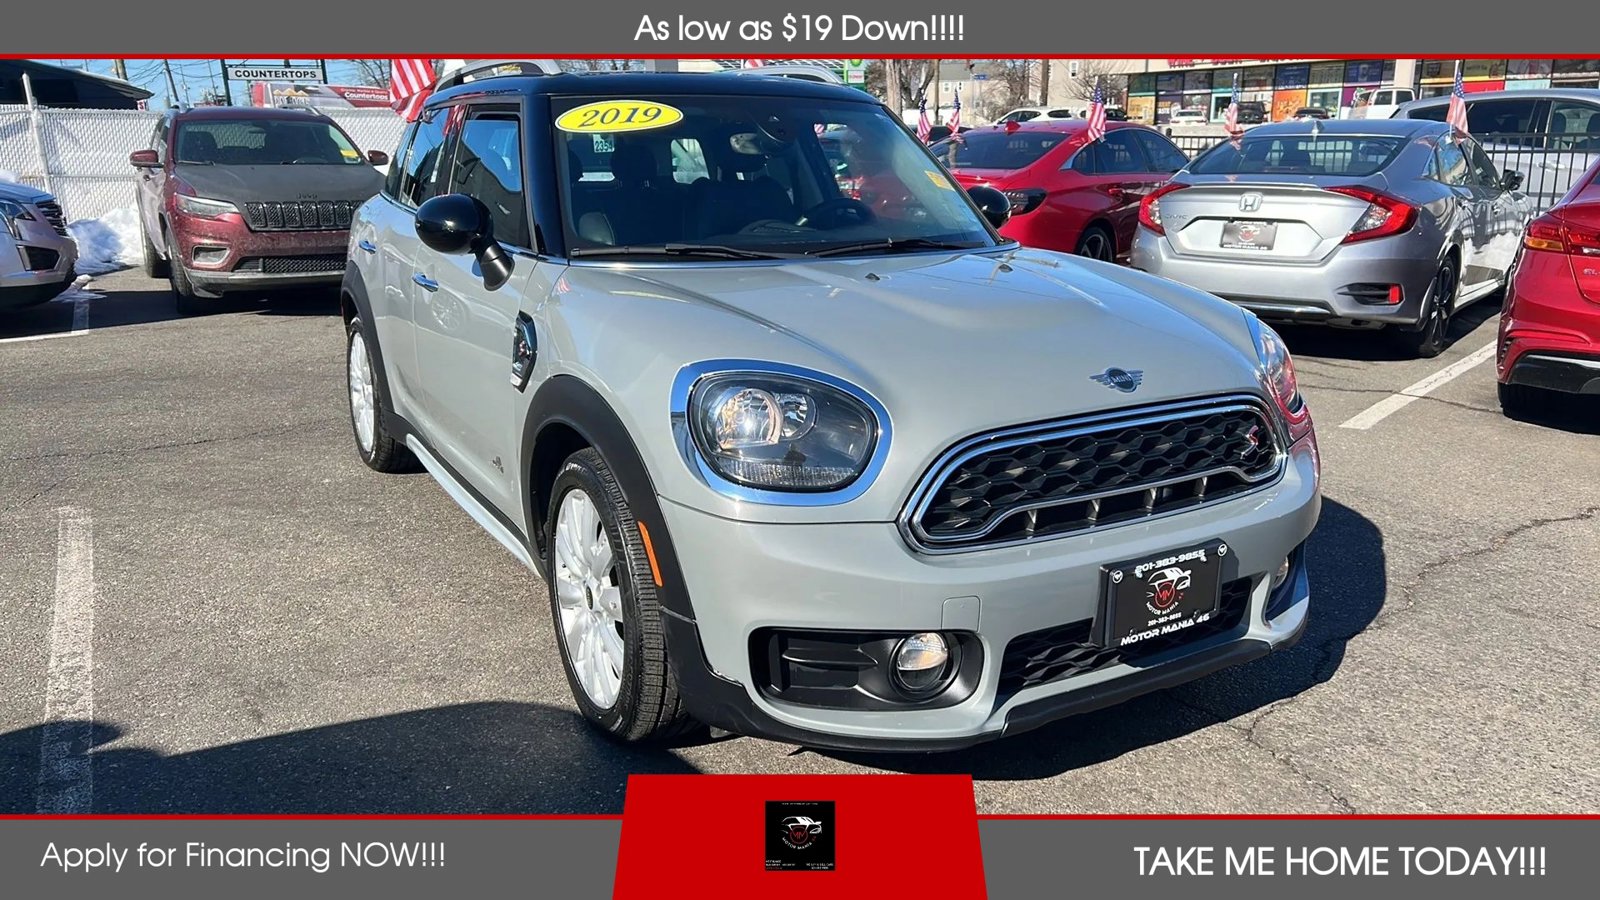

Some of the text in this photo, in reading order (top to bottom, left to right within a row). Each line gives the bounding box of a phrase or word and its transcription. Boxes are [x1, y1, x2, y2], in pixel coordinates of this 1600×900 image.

[234, 69, 317, 79] COUNTERTOPS
[344, 91, 388, 101] Countertops
[578, 106, 662, 128] 2019
[1120, 613, 1210, 646] MOTOR MANIA 46
